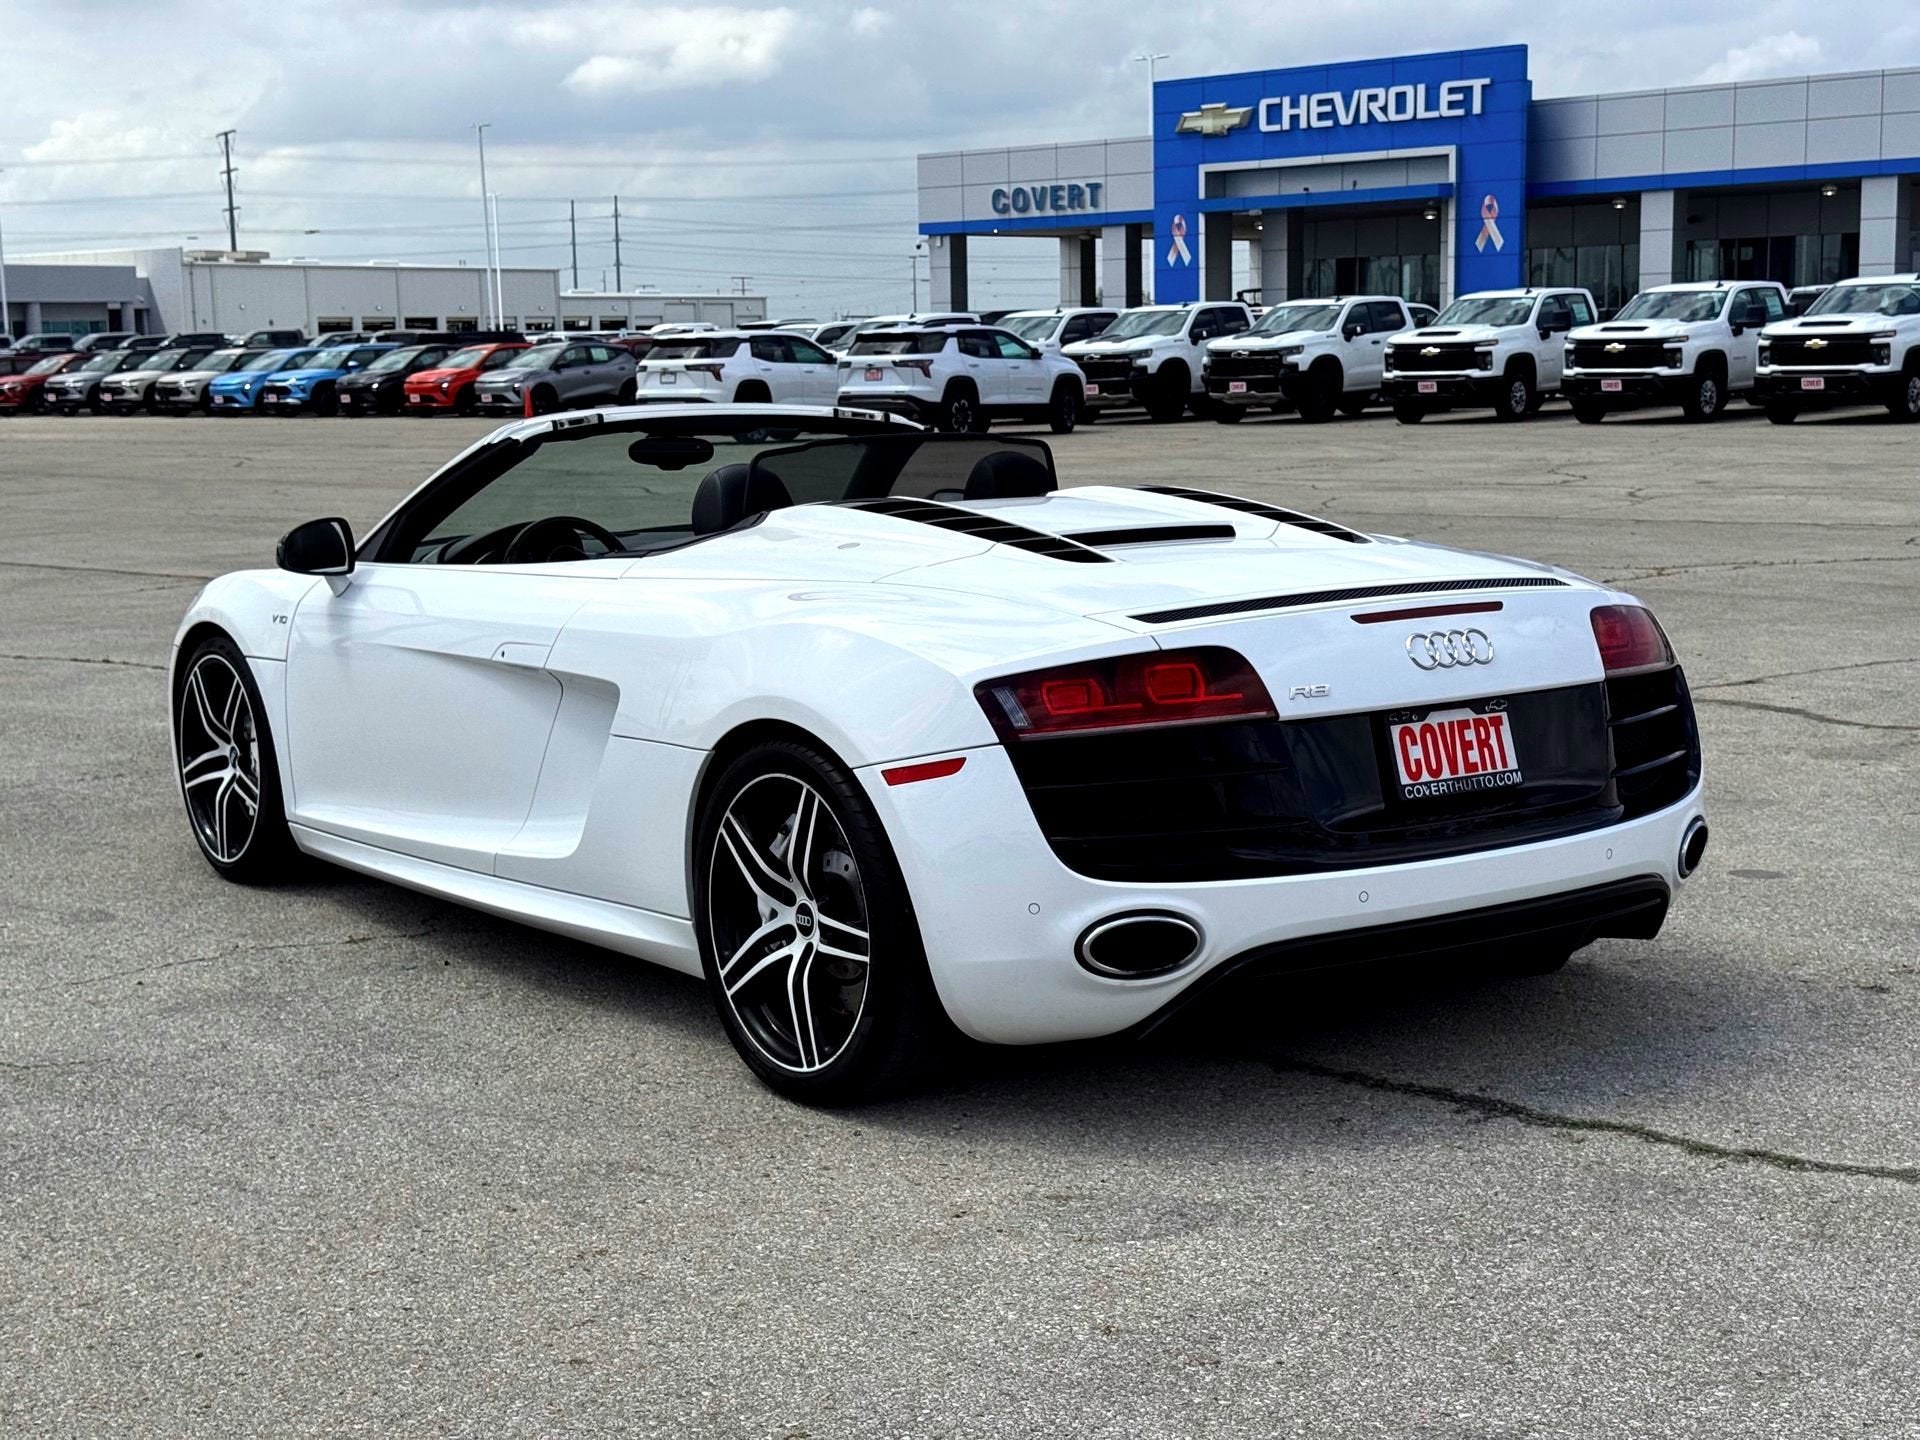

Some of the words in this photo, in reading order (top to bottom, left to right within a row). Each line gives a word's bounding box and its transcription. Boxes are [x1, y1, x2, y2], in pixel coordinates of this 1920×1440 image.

[1258, 77, 1491, 133] CHEVROLET
[991, 182, 1103, 215] COVERT
[272, 614, 288, 624] V10
[1289, 684, 1330, 700] R8
[1399, 715, 1509, 782] COVERT
[1405, 771, 1523, 799] COVERTHUTTO.COM
